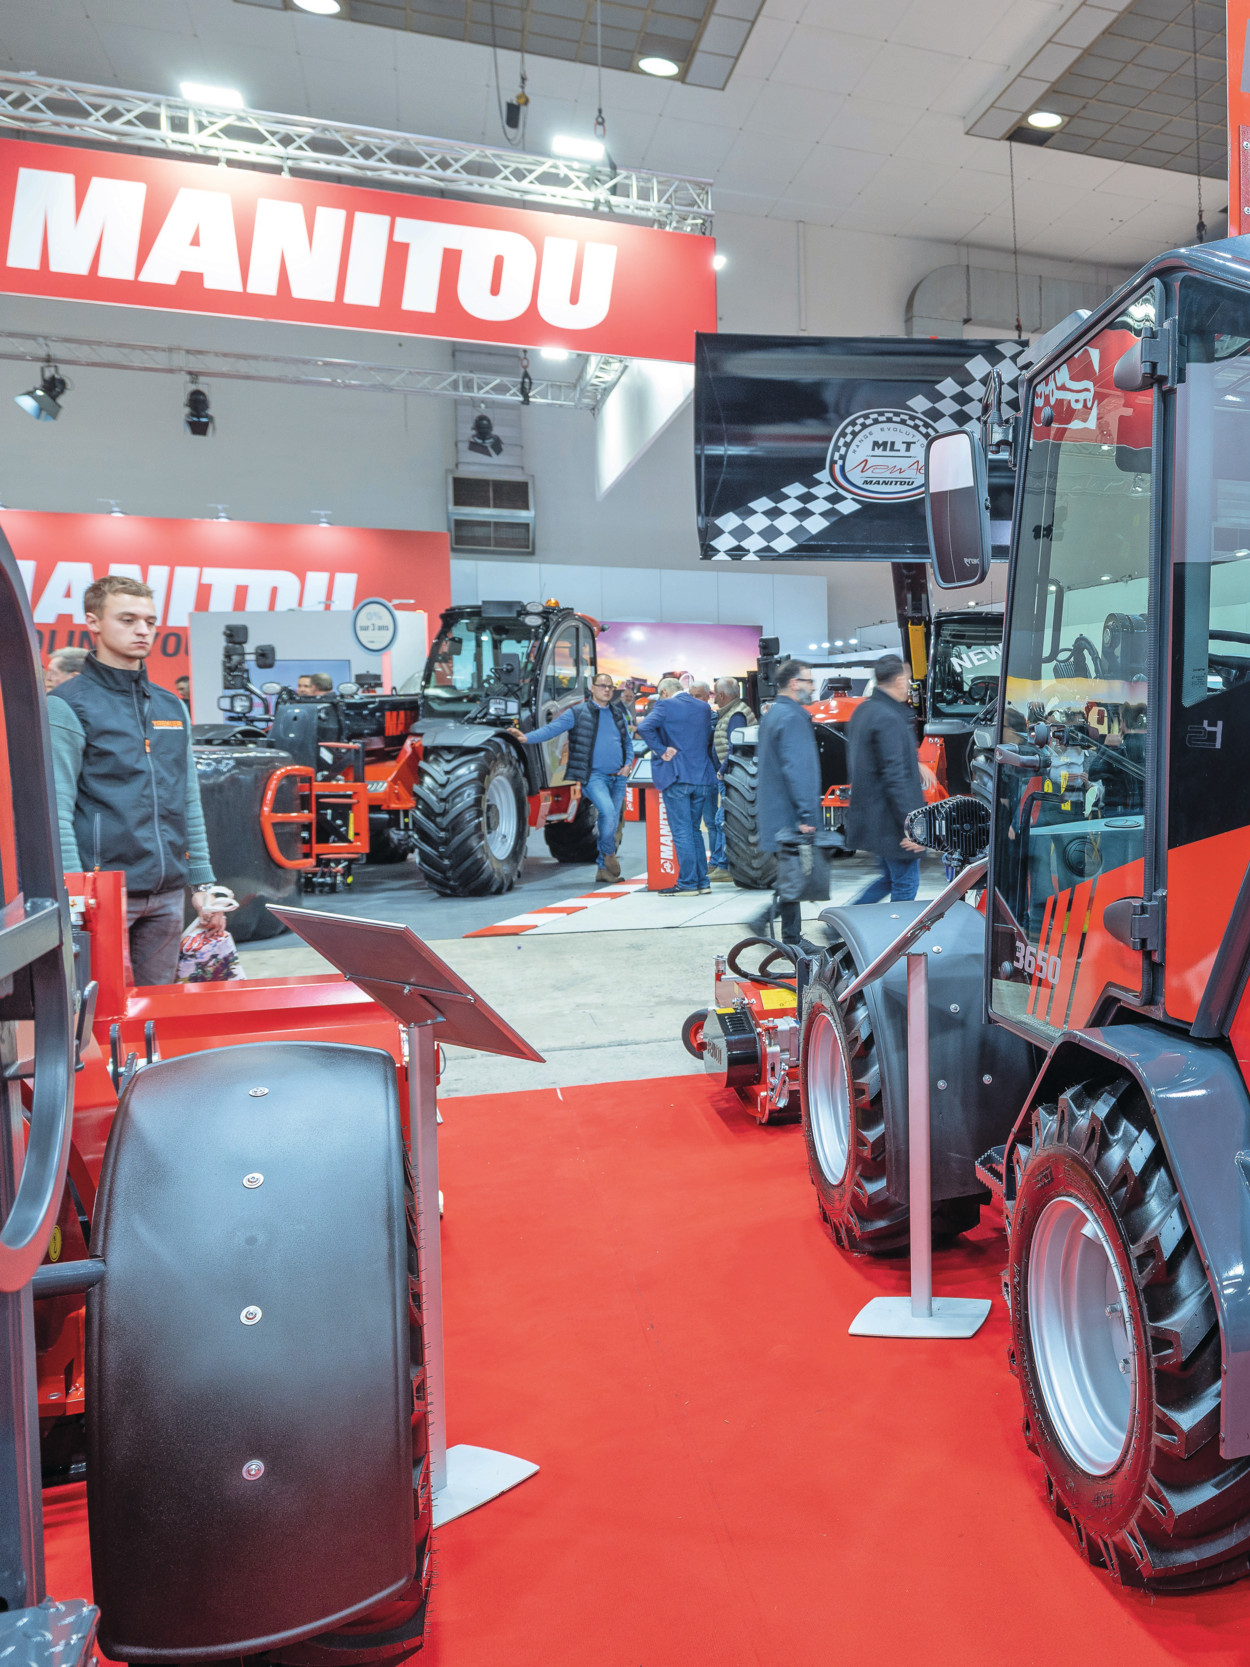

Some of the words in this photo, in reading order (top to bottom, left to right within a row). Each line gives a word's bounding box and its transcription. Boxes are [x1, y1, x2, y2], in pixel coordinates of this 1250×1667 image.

[6, 167, 618, 330] MANITOU
[871, 440, 917, 452] MLT
[879, 427, 925, 449] EVOLUTIO
[16, 559, 358, 627] ANITOU
[1013, 940, 1061, 985] 3650
